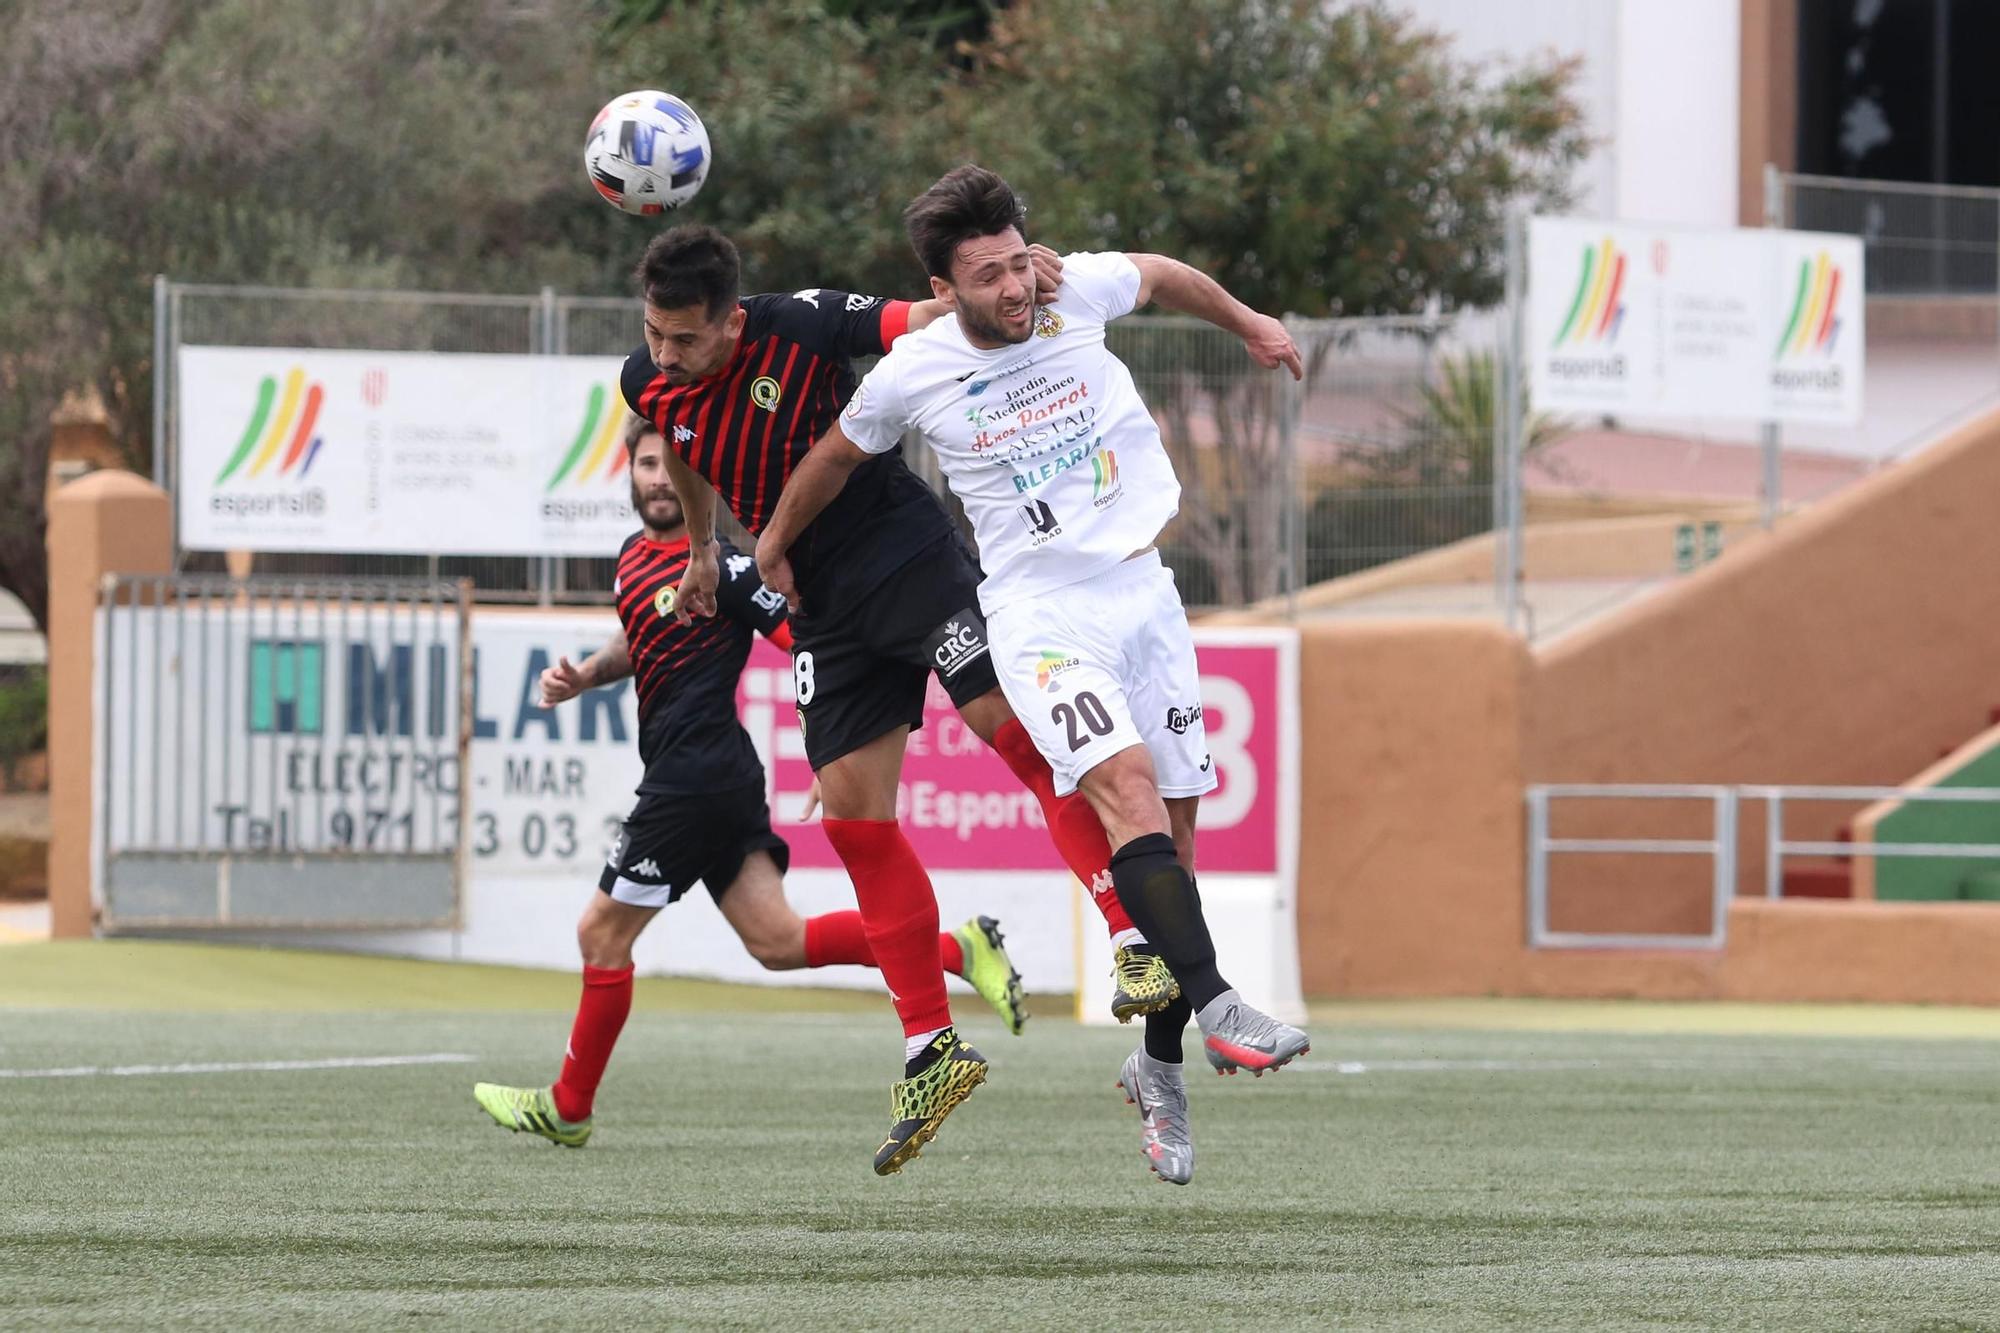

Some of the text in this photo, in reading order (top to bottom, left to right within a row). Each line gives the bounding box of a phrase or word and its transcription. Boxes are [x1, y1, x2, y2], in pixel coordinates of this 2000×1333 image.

[1017, 381, 1089, 429] Parrot
[935, 626, 979, 666] CRC
[1051, 691, 1114, 753] 20
[503, 754, 586, 797] MAR
[522, 812, 580, 859] 03
